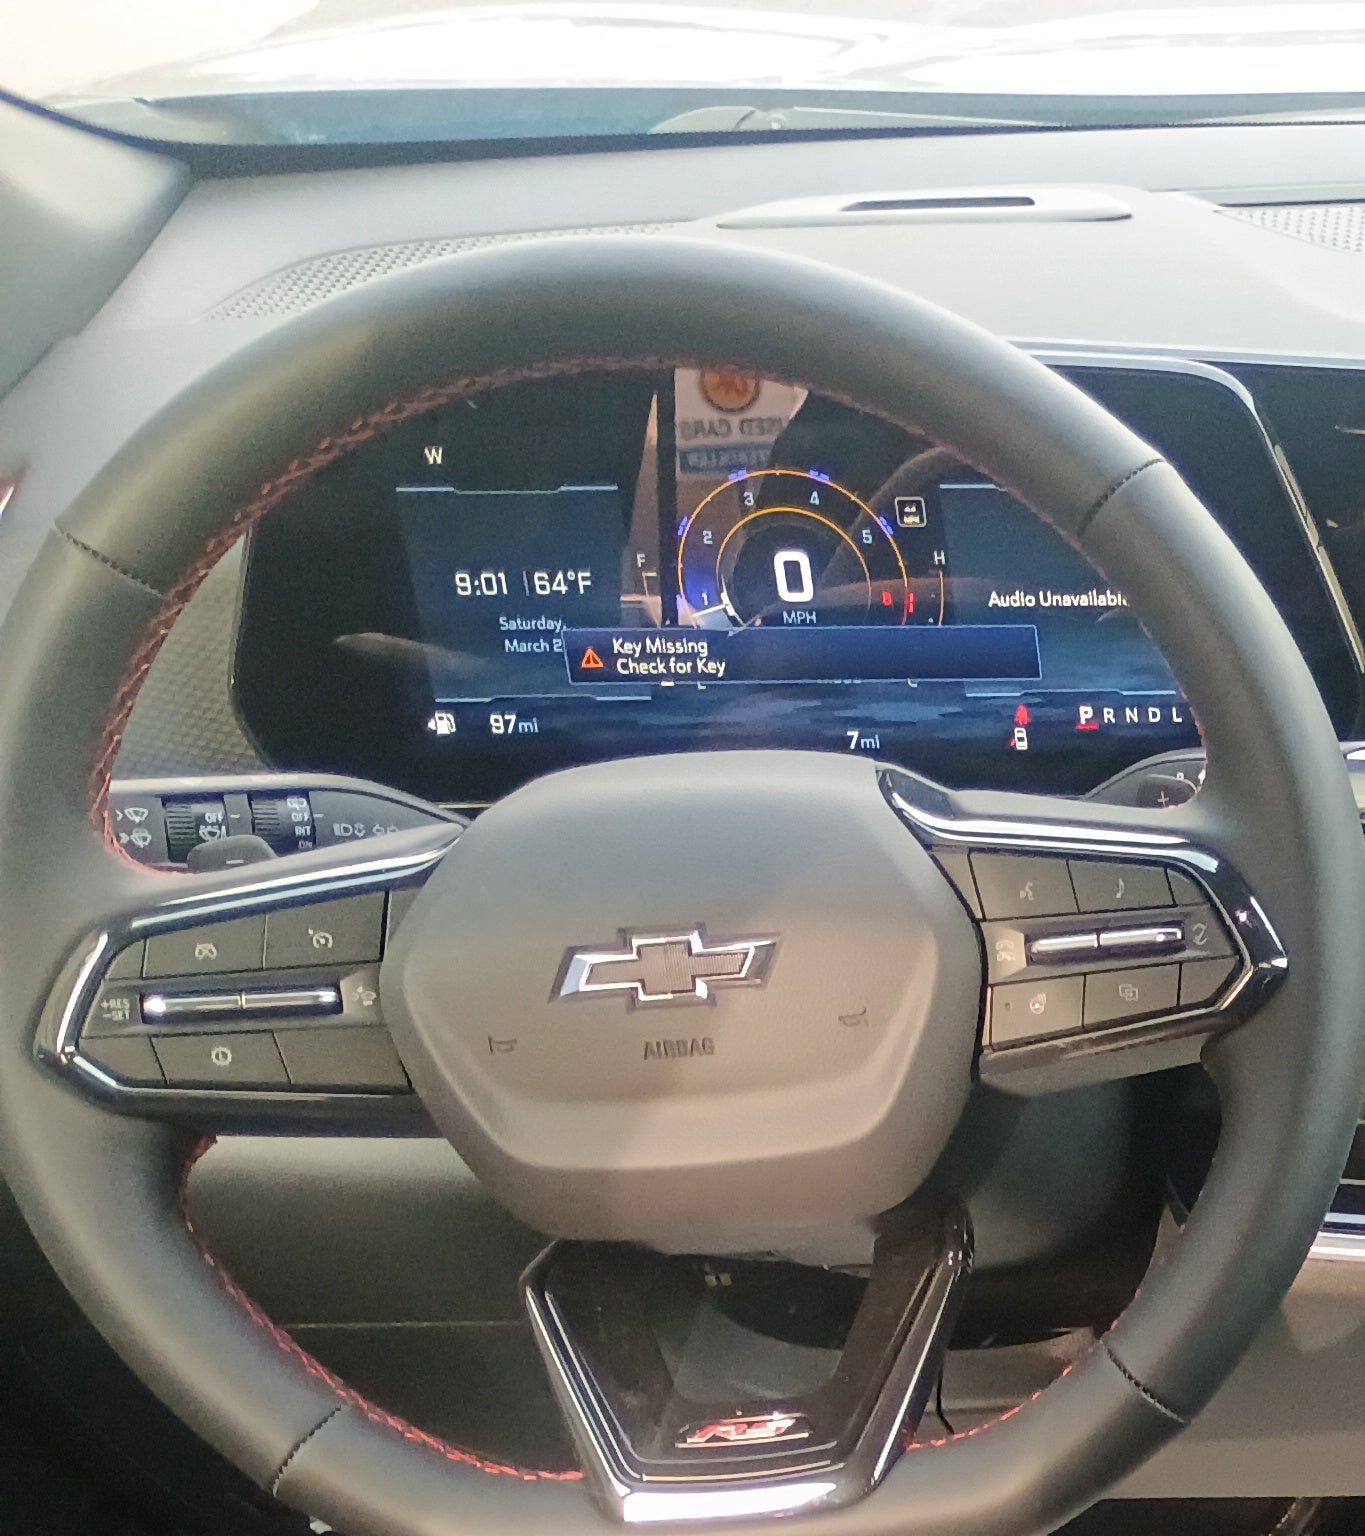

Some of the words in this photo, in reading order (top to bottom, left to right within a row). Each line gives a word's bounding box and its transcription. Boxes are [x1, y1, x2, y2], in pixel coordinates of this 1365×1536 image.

[425, 448, 443, 464] W
[744, 492, 754, 506] 3
[810, 492, 820, 506] 4
[703, 531, 713, 545] 2
[862, 530, 873, 544] 5
[637, 554, 646, 567] F
[933, 551, 946, 566] H
[456, 571, 508, 596] 9:01
[535, 571, 592, 596] 64°F
[774, 551, 814, 602] 0
[702, 593, 708, 605] 1
[988, 590, 1036, 607] Audio
[783, 611, 817, 624] MPH
[504, 638, 550, 653] March
[613, 638, 641, 655] Key
[646, 638, 708, 657] Missing
[616, 658, 666, 675] Check
[669, 658, 693, 674] for
[697, 659, 726, 677] Key
[1079, 706, 1093, 725] P
[1104, 707, 1115, 724] R
[1126, 707, 1139, 724] N
[1149, 707, 1160, 723] D
[1173, 707, 1182, 723] L
[644, 1037, 715, 1060] AIRBAG
